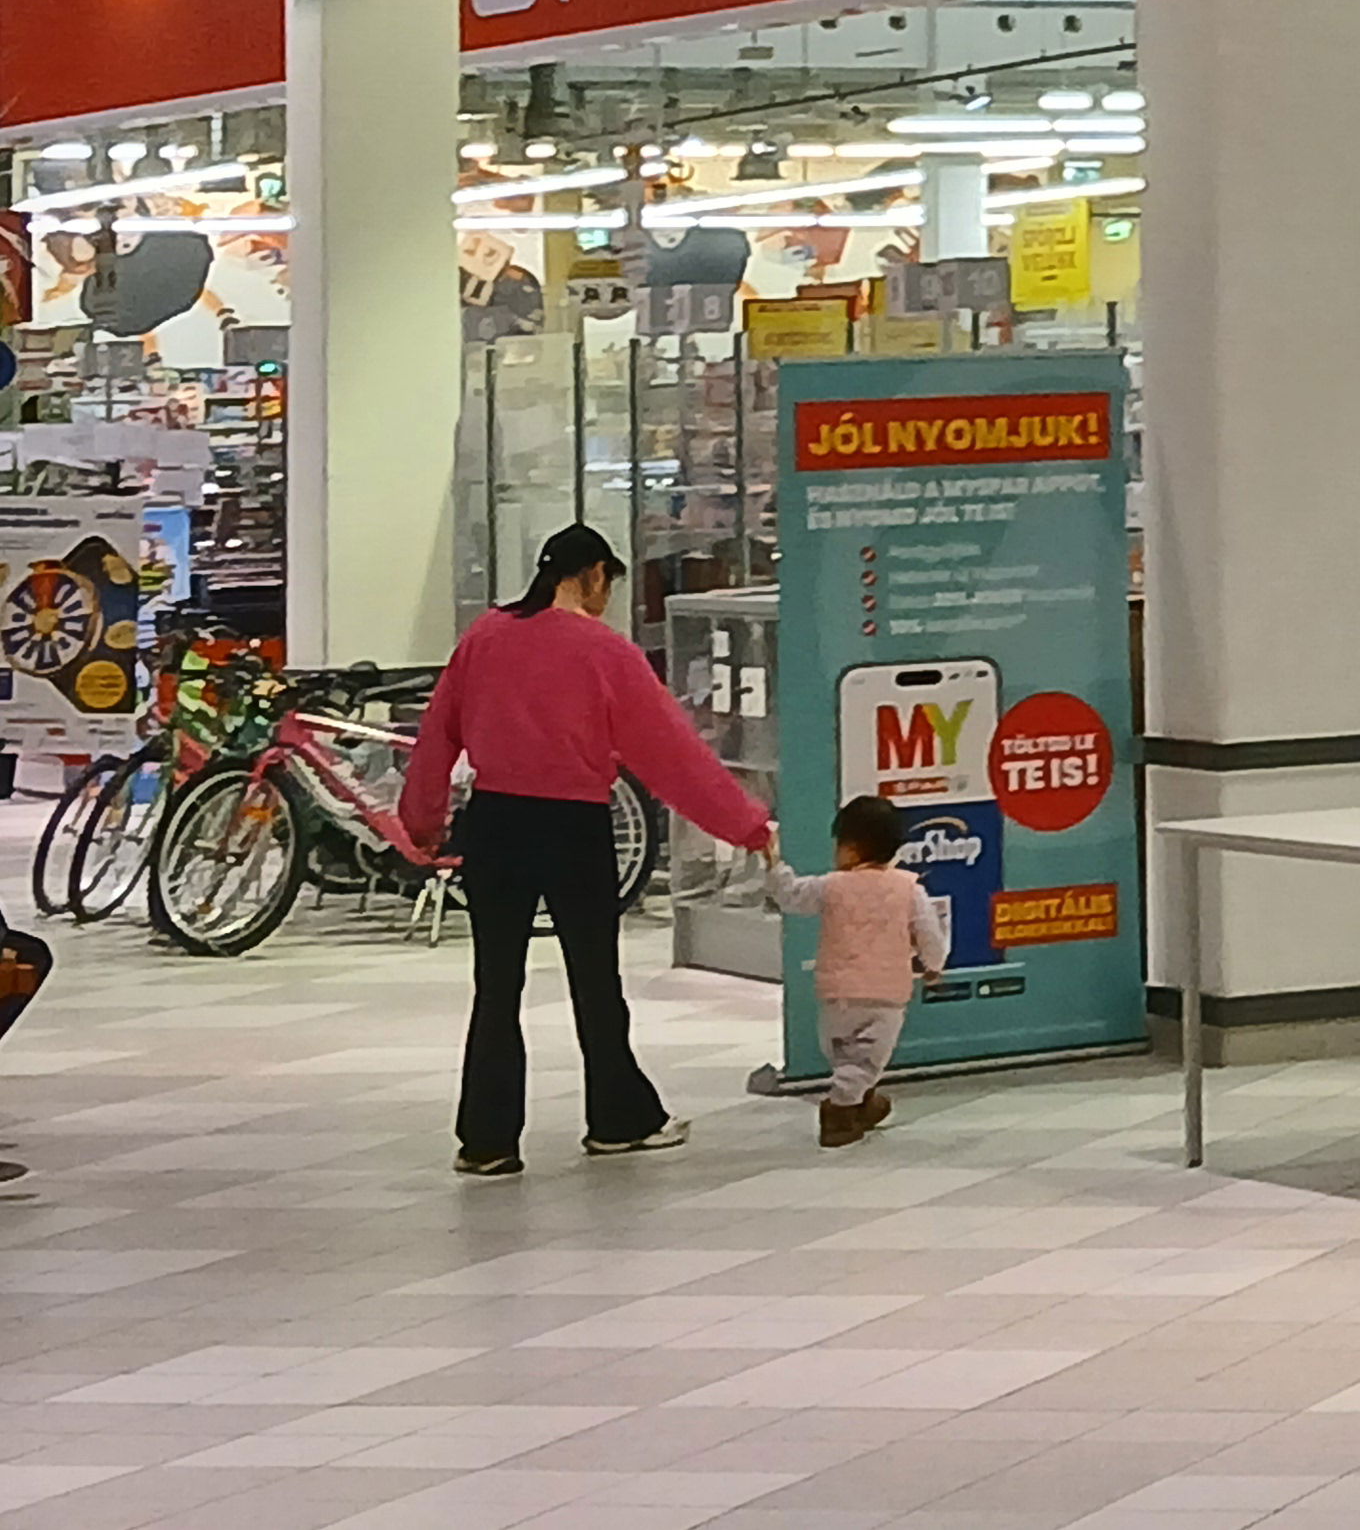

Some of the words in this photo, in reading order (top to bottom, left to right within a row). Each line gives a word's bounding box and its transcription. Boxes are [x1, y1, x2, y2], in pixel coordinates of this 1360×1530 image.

[808, 412, 882, 456] JÓL
[887, 412, 1100, 454] NYOMJUK!
[876, 698, 974, 771] MY
[1001, 759, 1046, 792] TE
[1050, 753, 1099, 789] IS!
[995, 891, 1114, 923] DIGITÁLIS
